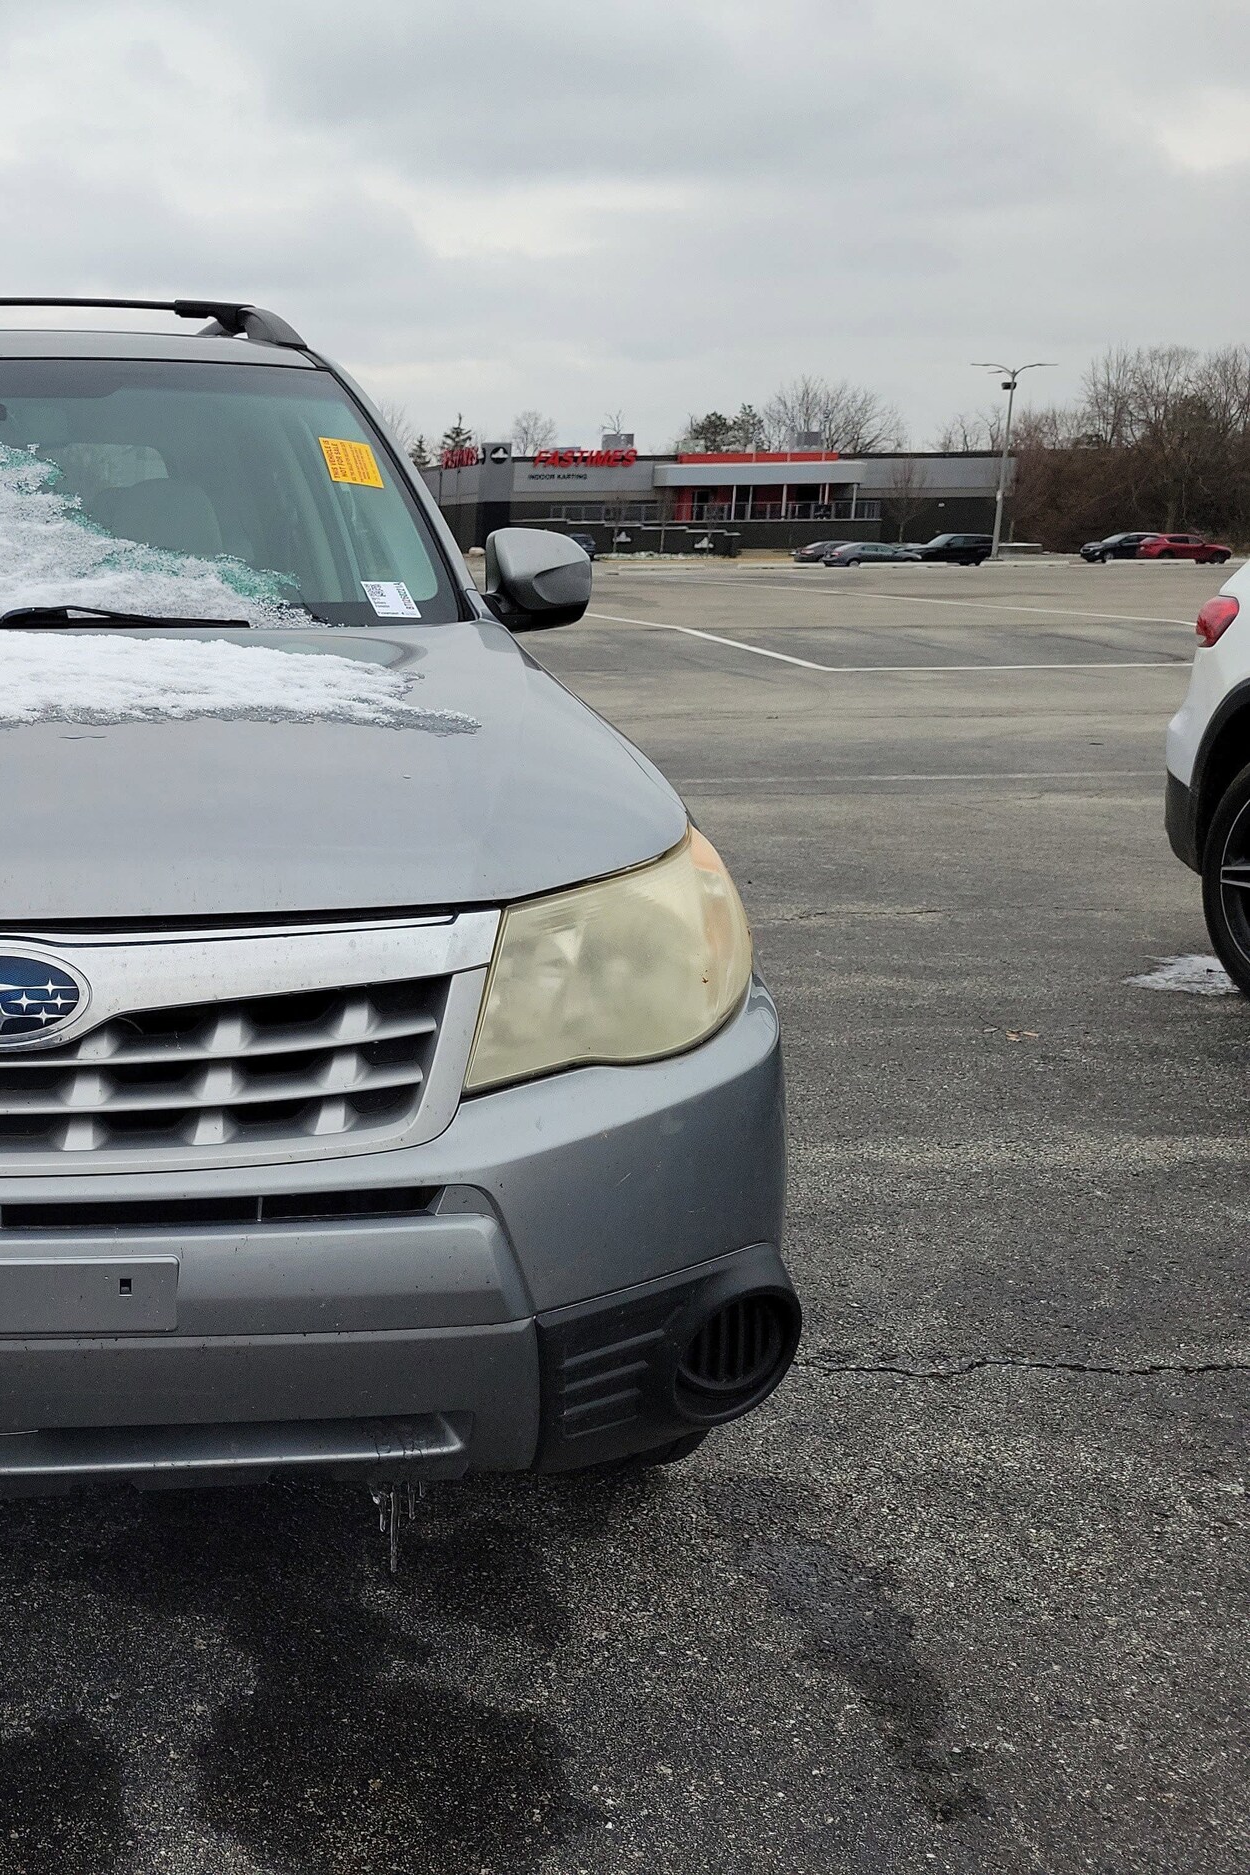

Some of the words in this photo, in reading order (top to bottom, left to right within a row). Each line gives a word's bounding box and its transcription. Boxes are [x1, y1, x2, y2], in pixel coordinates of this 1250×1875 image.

[331, 442, 341, 455] SALE
[335, 455, 345, 466] FOR
[533, 448, 637, 468] FASTIMES
[331, 466, 341, 479] THIS
[339, 466, 348, 477] NOT
